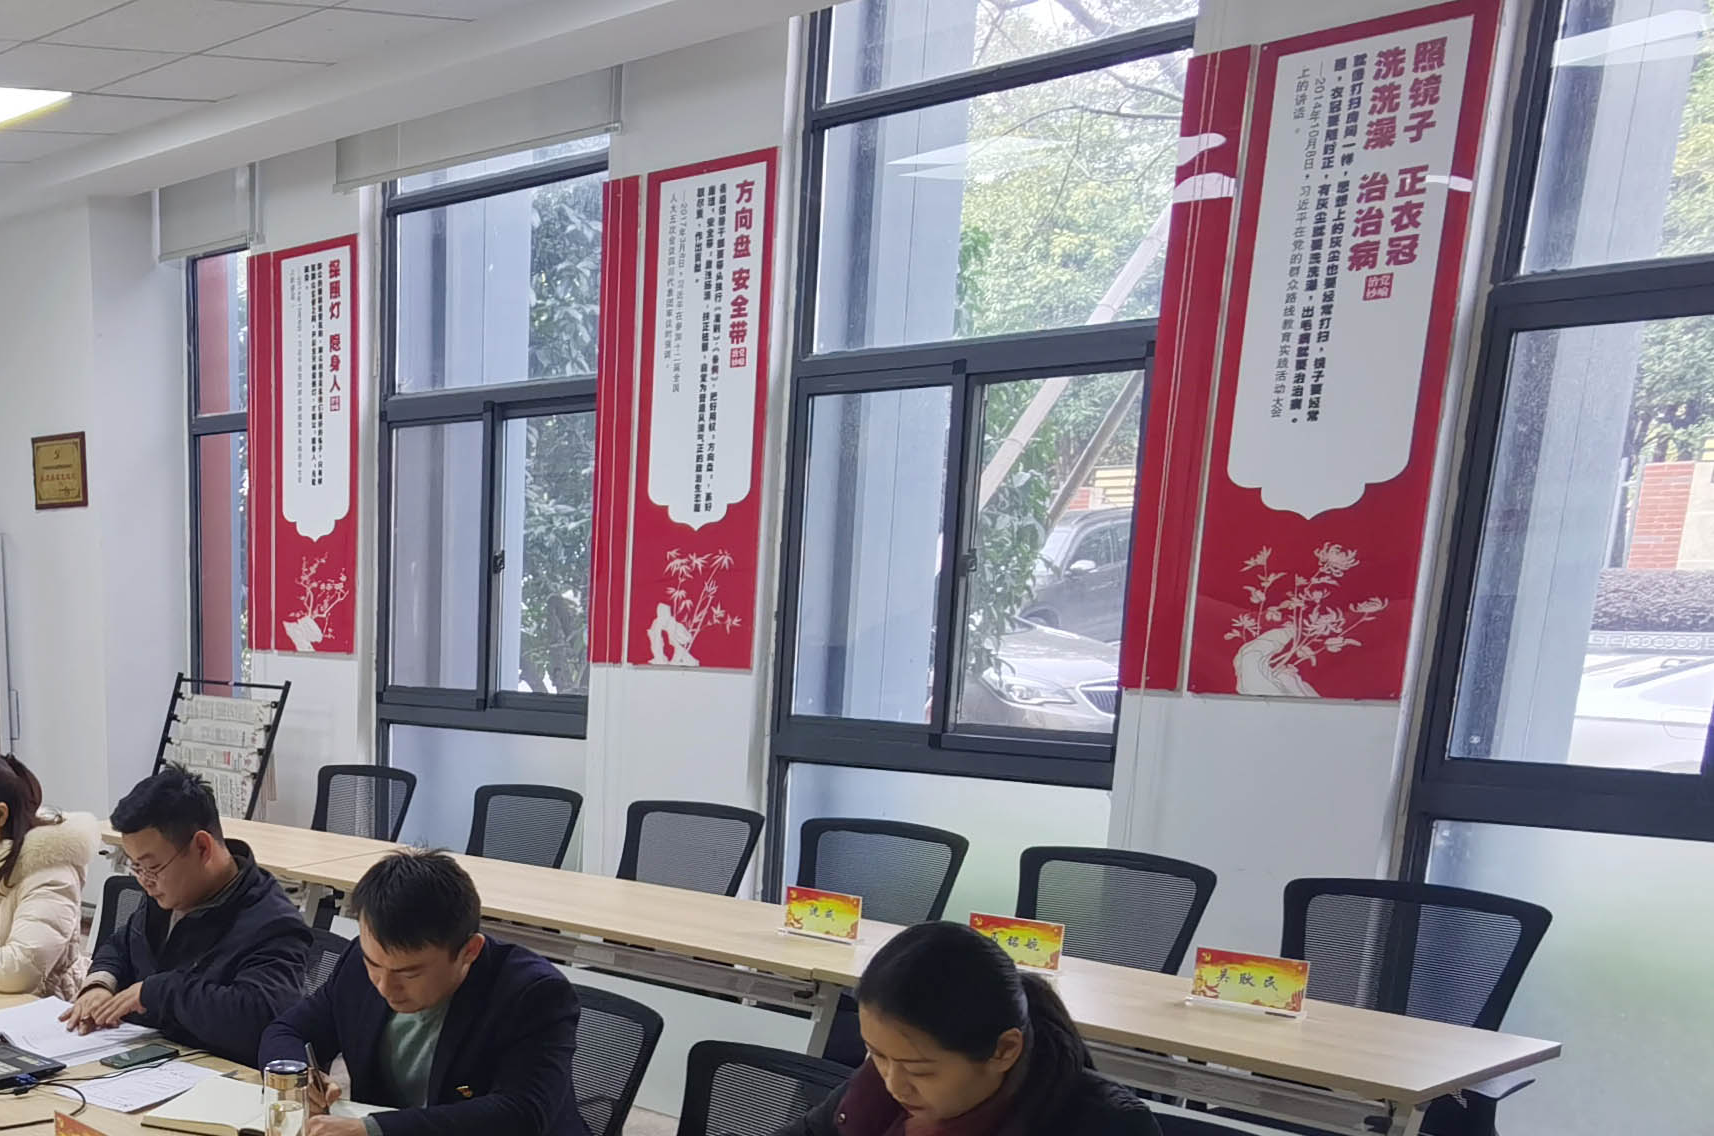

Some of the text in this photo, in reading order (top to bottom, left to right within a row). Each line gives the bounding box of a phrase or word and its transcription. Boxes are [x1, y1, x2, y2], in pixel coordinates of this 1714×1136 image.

[1347, 46, 1406, 272] 洗洗澡 治治病
[1385, 36, 1448, 267] 照镜子 正衣冠
[329, 259, 340, 320] 探照灯
[729, 179, 755, 345] 方向盘 安全带
[329, 334, 341, 392] 隐身人
